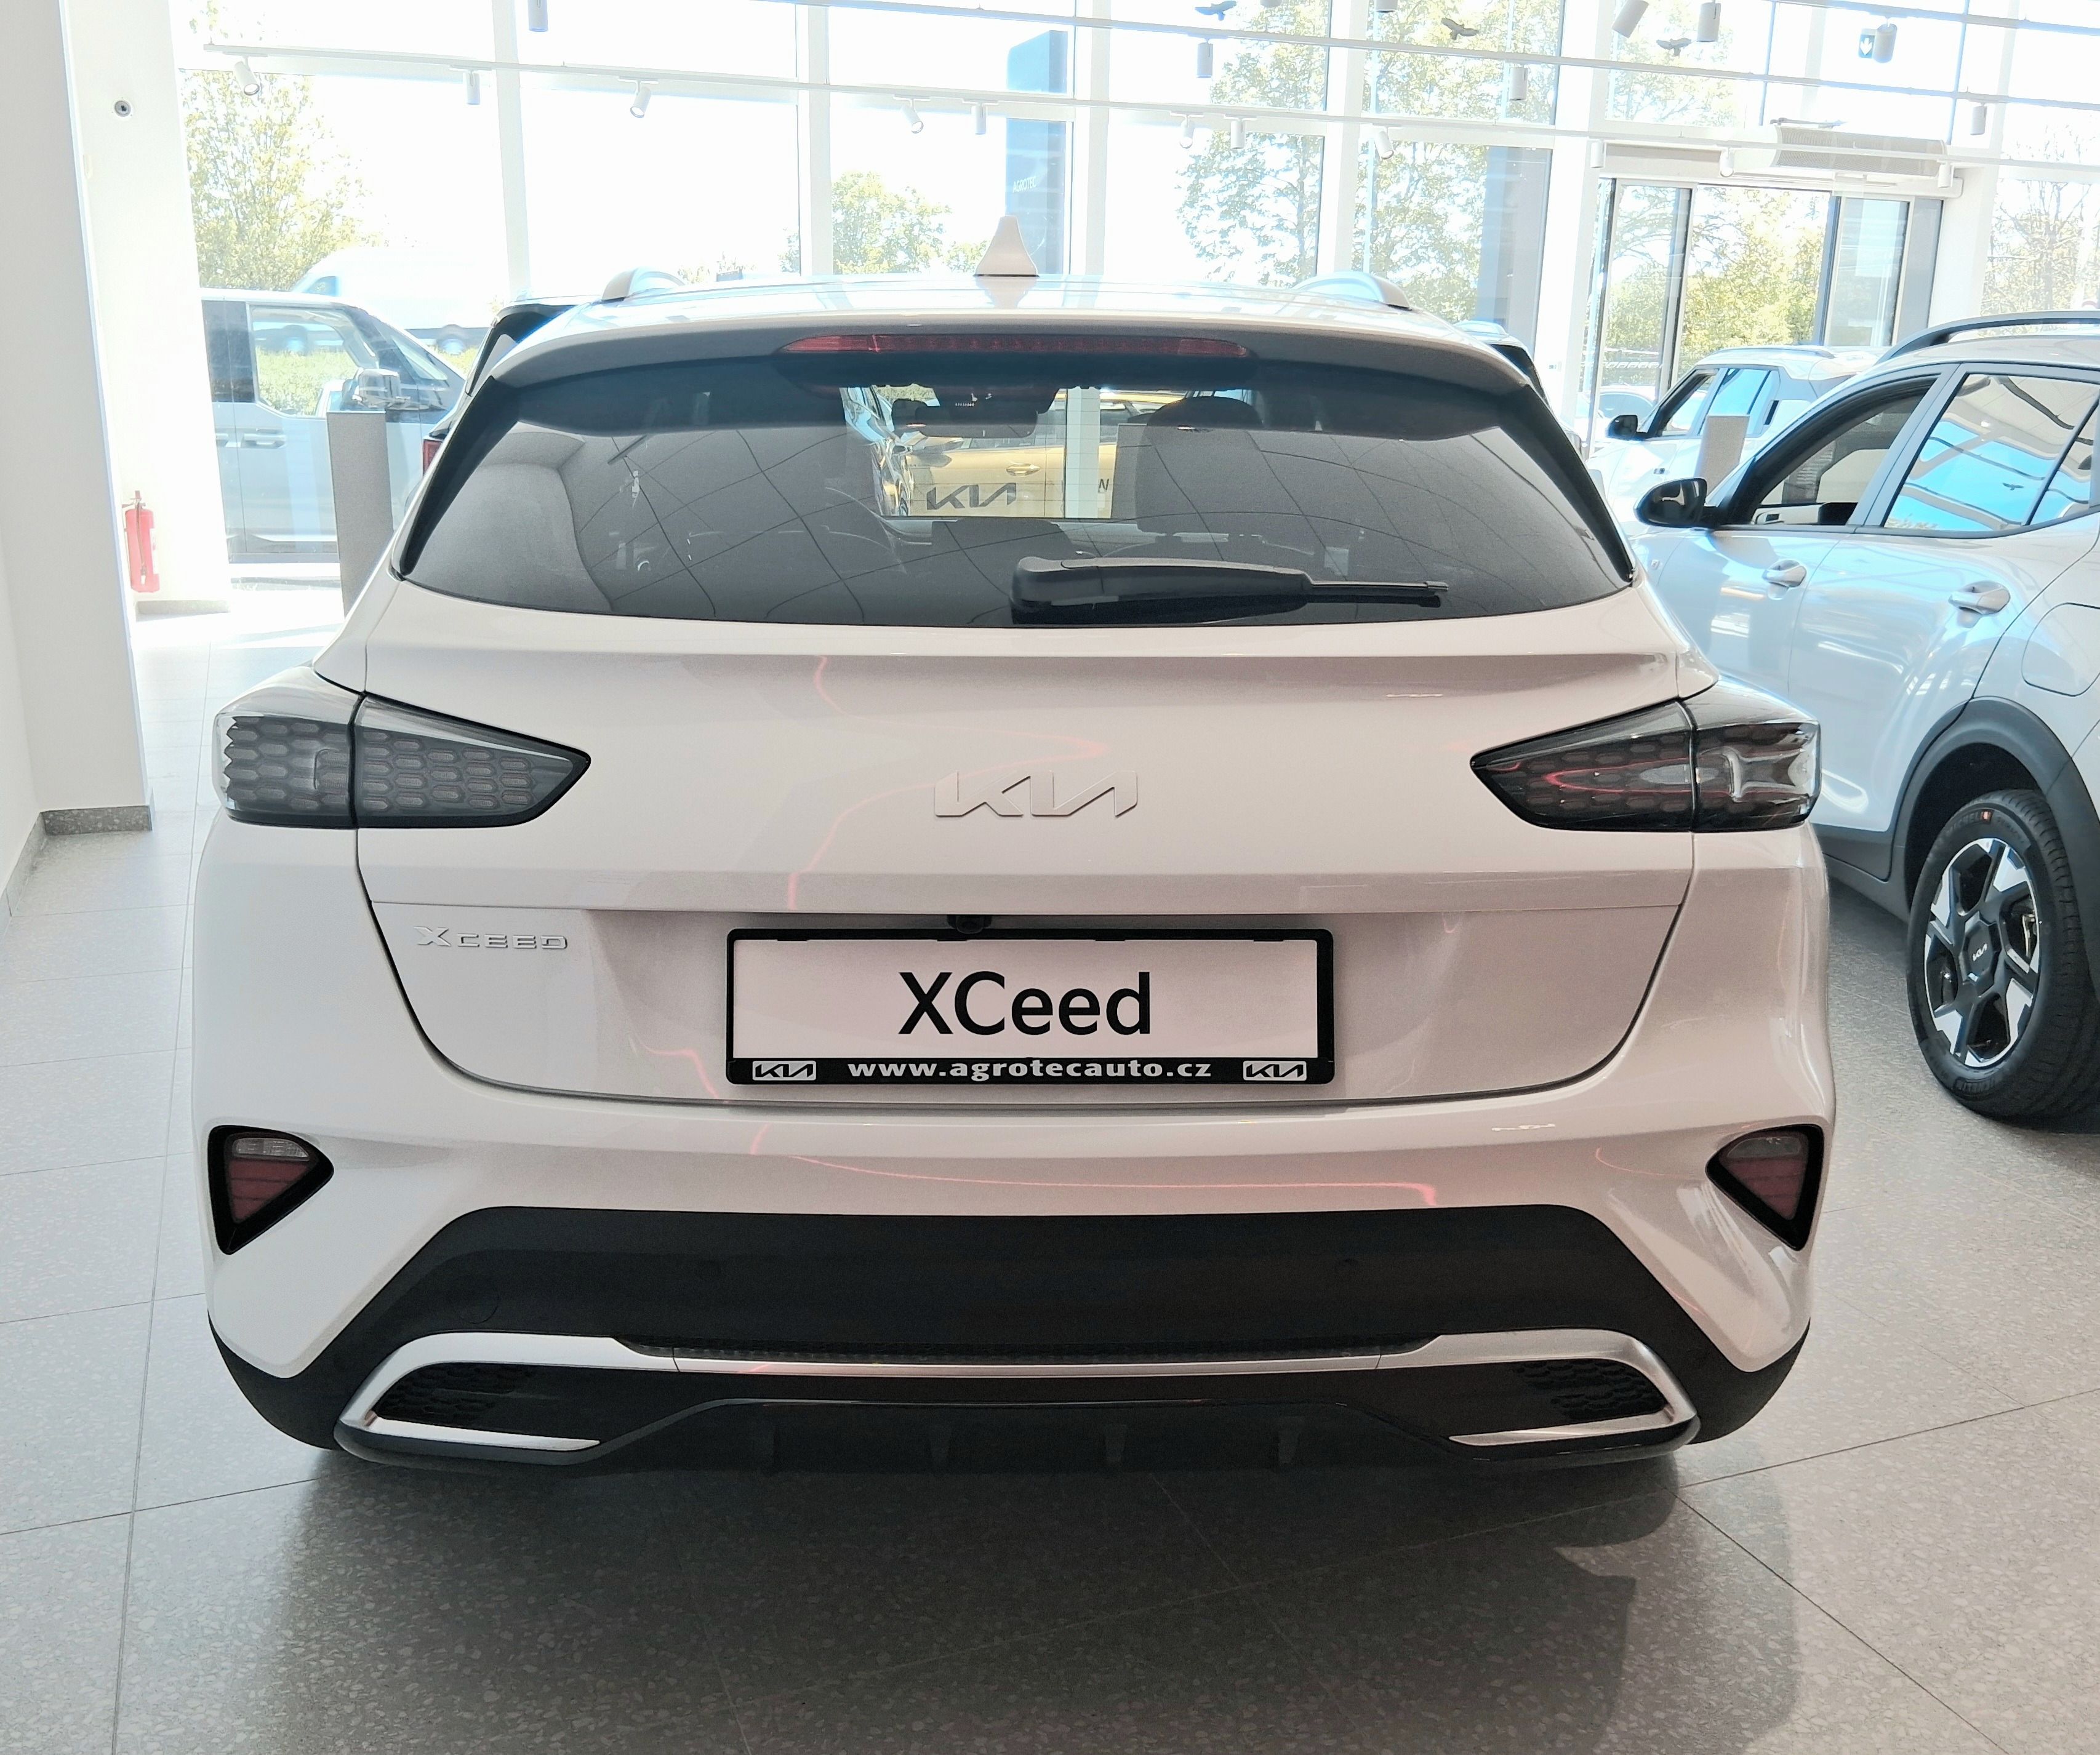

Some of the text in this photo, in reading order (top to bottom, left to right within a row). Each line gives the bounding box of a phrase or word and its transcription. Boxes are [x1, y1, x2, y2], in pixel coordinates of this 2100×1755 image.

[926, 482, 1016, 510] KIA
[934, 770, 1138, 817] KIA
[898, 970, 1150, 1036] XCeed
[755, 1063, 814, 1077] KIA
[848, 1060, 1211, 1082] www.agrotecauto.cz
[1246, 1063, 1304, 1077] KIA
